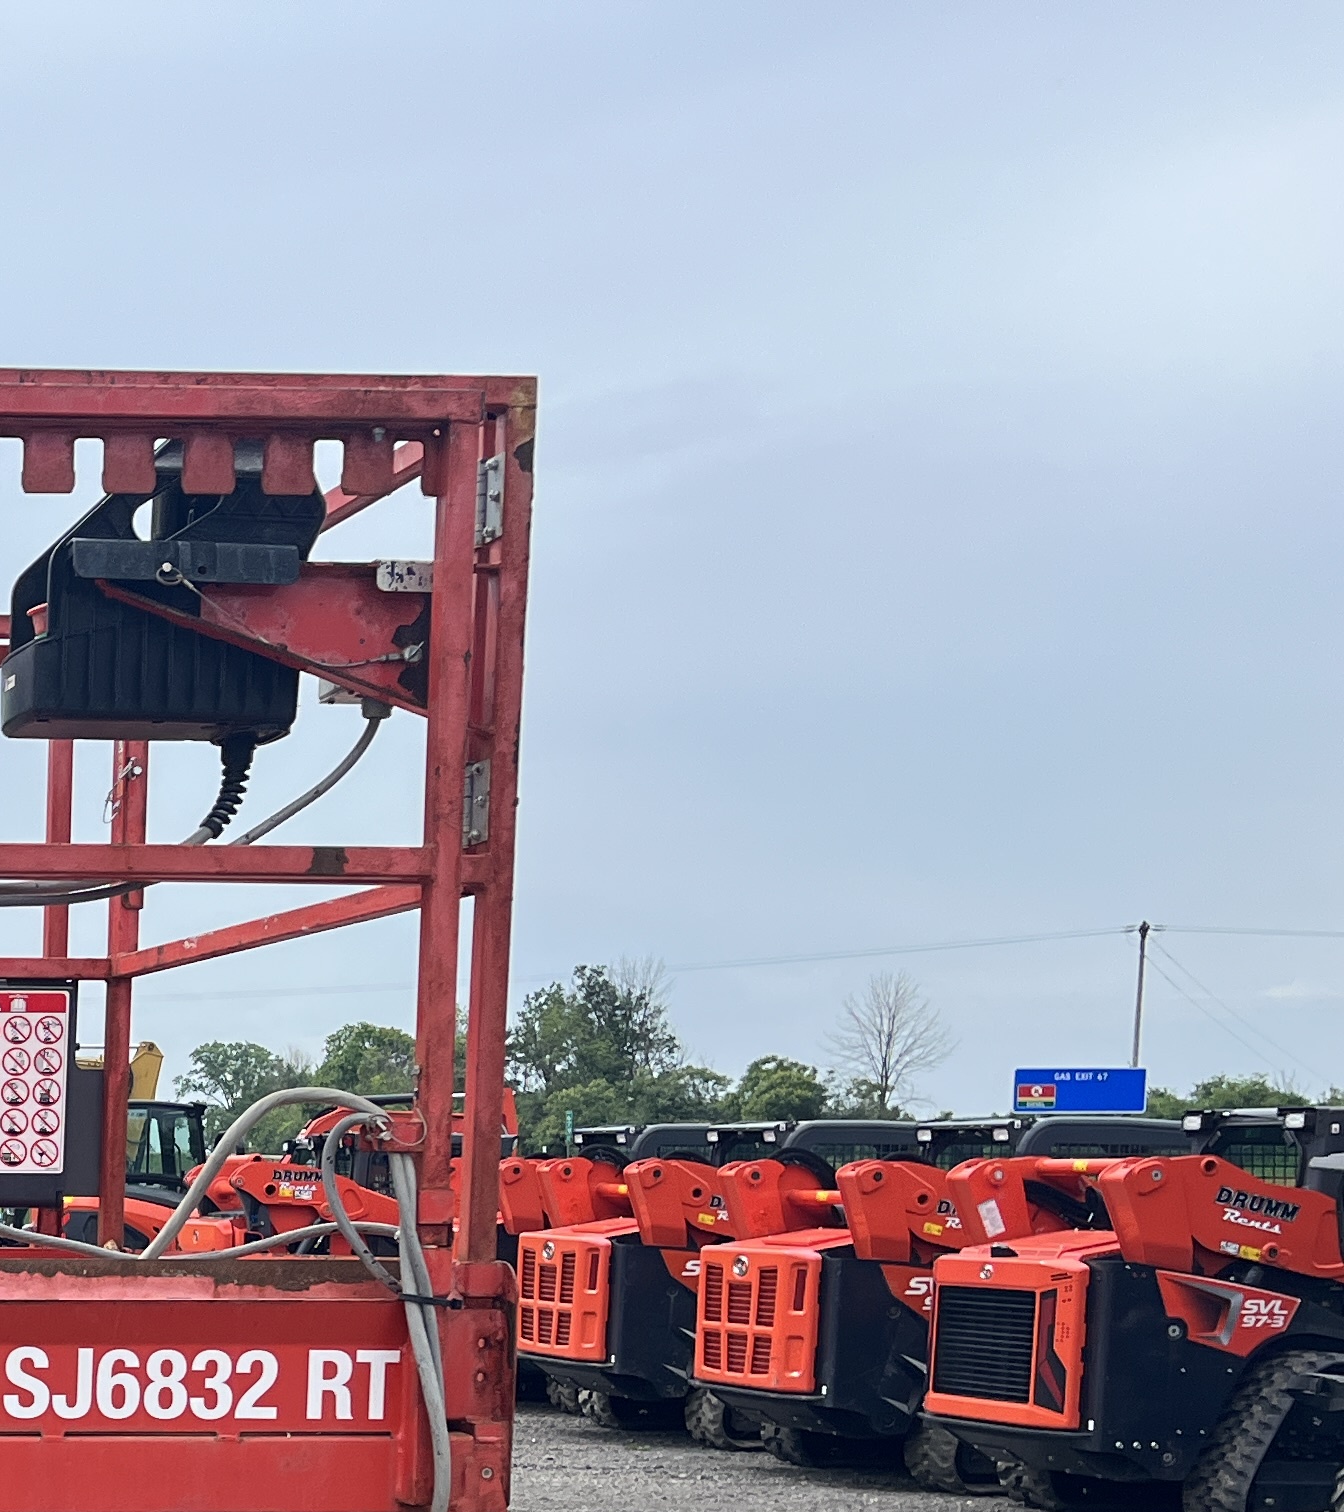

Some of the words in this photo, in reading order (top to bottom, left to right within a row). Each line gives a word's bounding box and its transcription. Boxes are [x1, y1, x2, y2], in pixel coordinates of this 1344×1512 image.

[1054, 1072, 1071, 1081] GAS
[1075, 1072, 1094, 1081] EXIT
[272, 1169, 324, 1182] DRUMM
[1215, 1185, 1301, 1222] DRUMM
[1223, 1207, 1282, 1234] Rents
[1240, 1299, 1288, 1315] SVL
[1241, 1315, 1284, 1328] 97-3
[3, 1345, 279, 1421] SJ6832
[305, 1349, 401, 1421] RT
